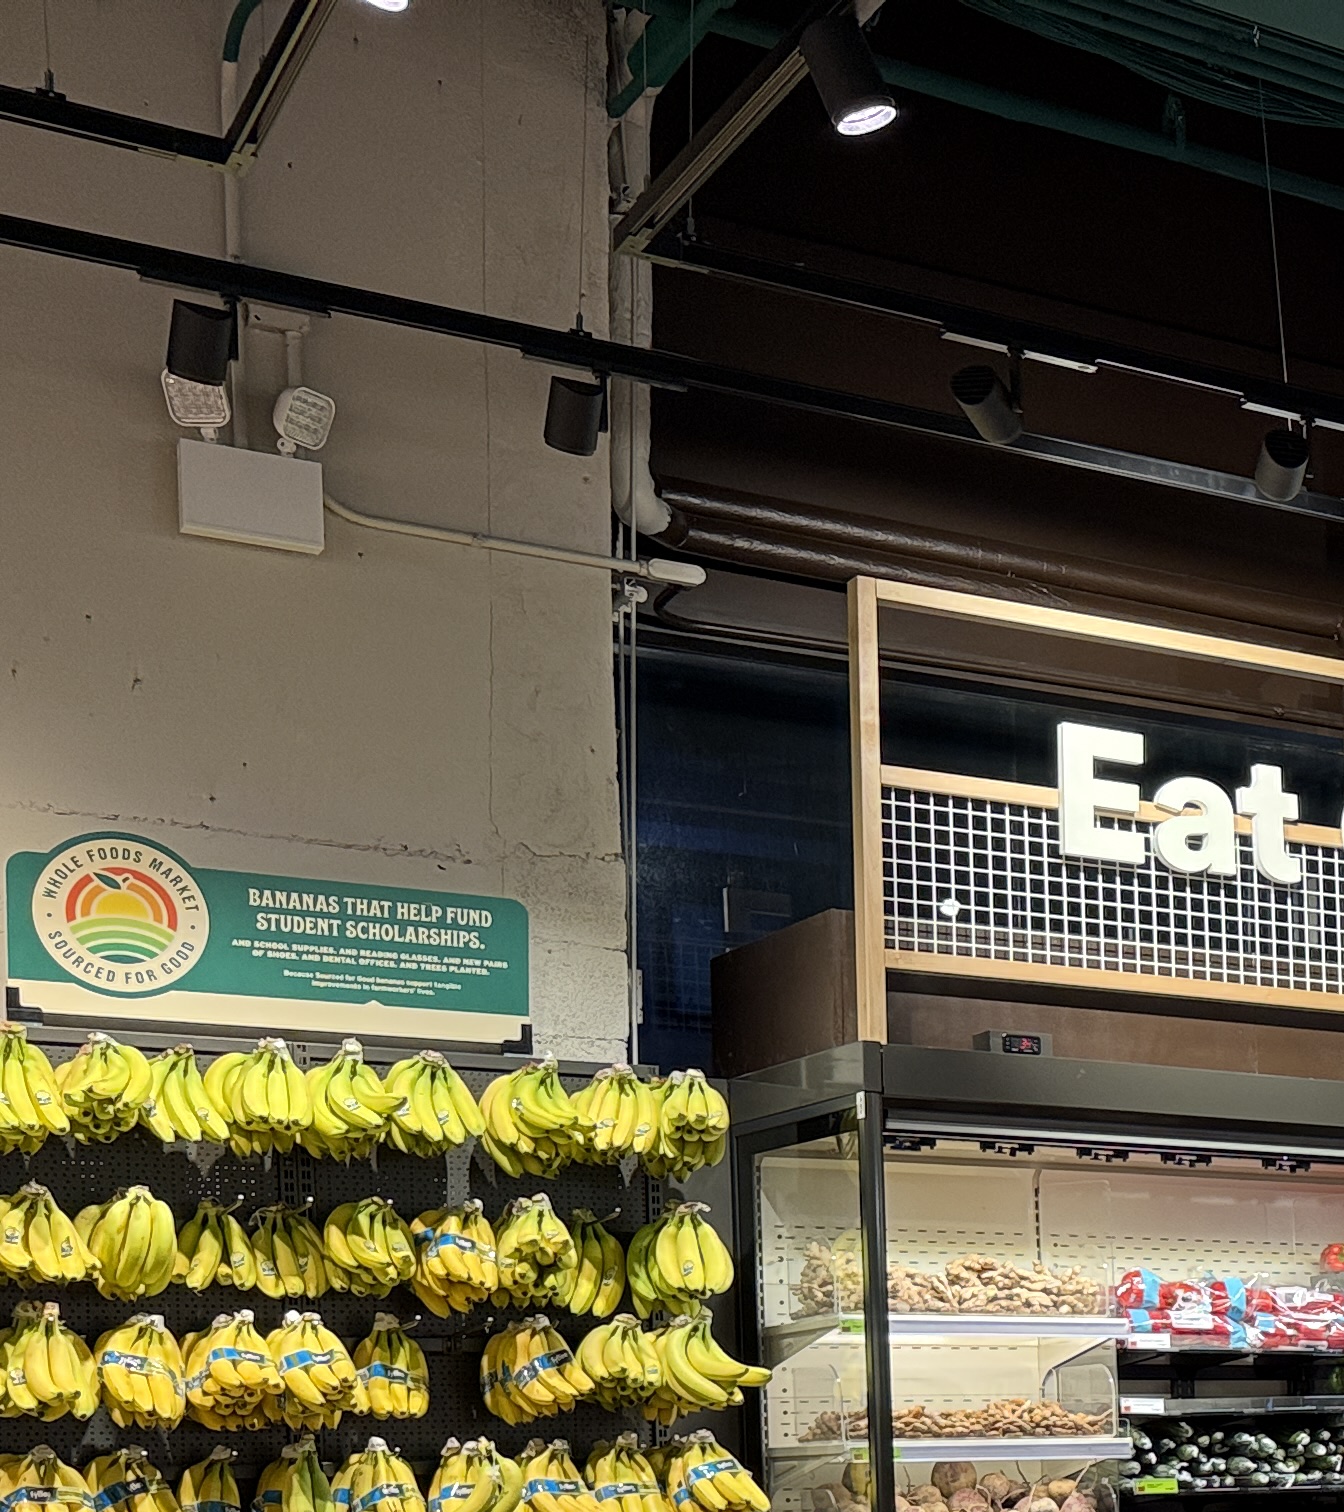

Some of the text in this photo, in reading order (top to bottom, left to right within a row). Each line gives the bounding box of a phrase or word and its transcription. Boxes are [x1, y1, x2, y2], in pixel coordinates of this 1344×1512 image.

[1057, 721, 1301, 884] Eat
[42, 846, 200, 912] WHOLE FOODS MARKET
[248, 888, 493, 928] BANANAS THAT HELP FUND
[255, 912, 487, 950] STUDENT SCHOLARSHIPS.
[47, 930, 195, 985] SOURCED FOR GOOD
[231, 938, 252, 948] AND
[253, 939, 290, 951] SCHOOL
[337, 945, 359, 956] AND
[442, 955, 462, 966] AND
[462, 957, 483, 968] NEW
[252, 949, 266, 957] OF
[301, 952, 321, 962] AND
[322, 954, 357, 966] DENTAL
[399, 961, 419, 970] AND
[419, 962, 448, 973] TREES
